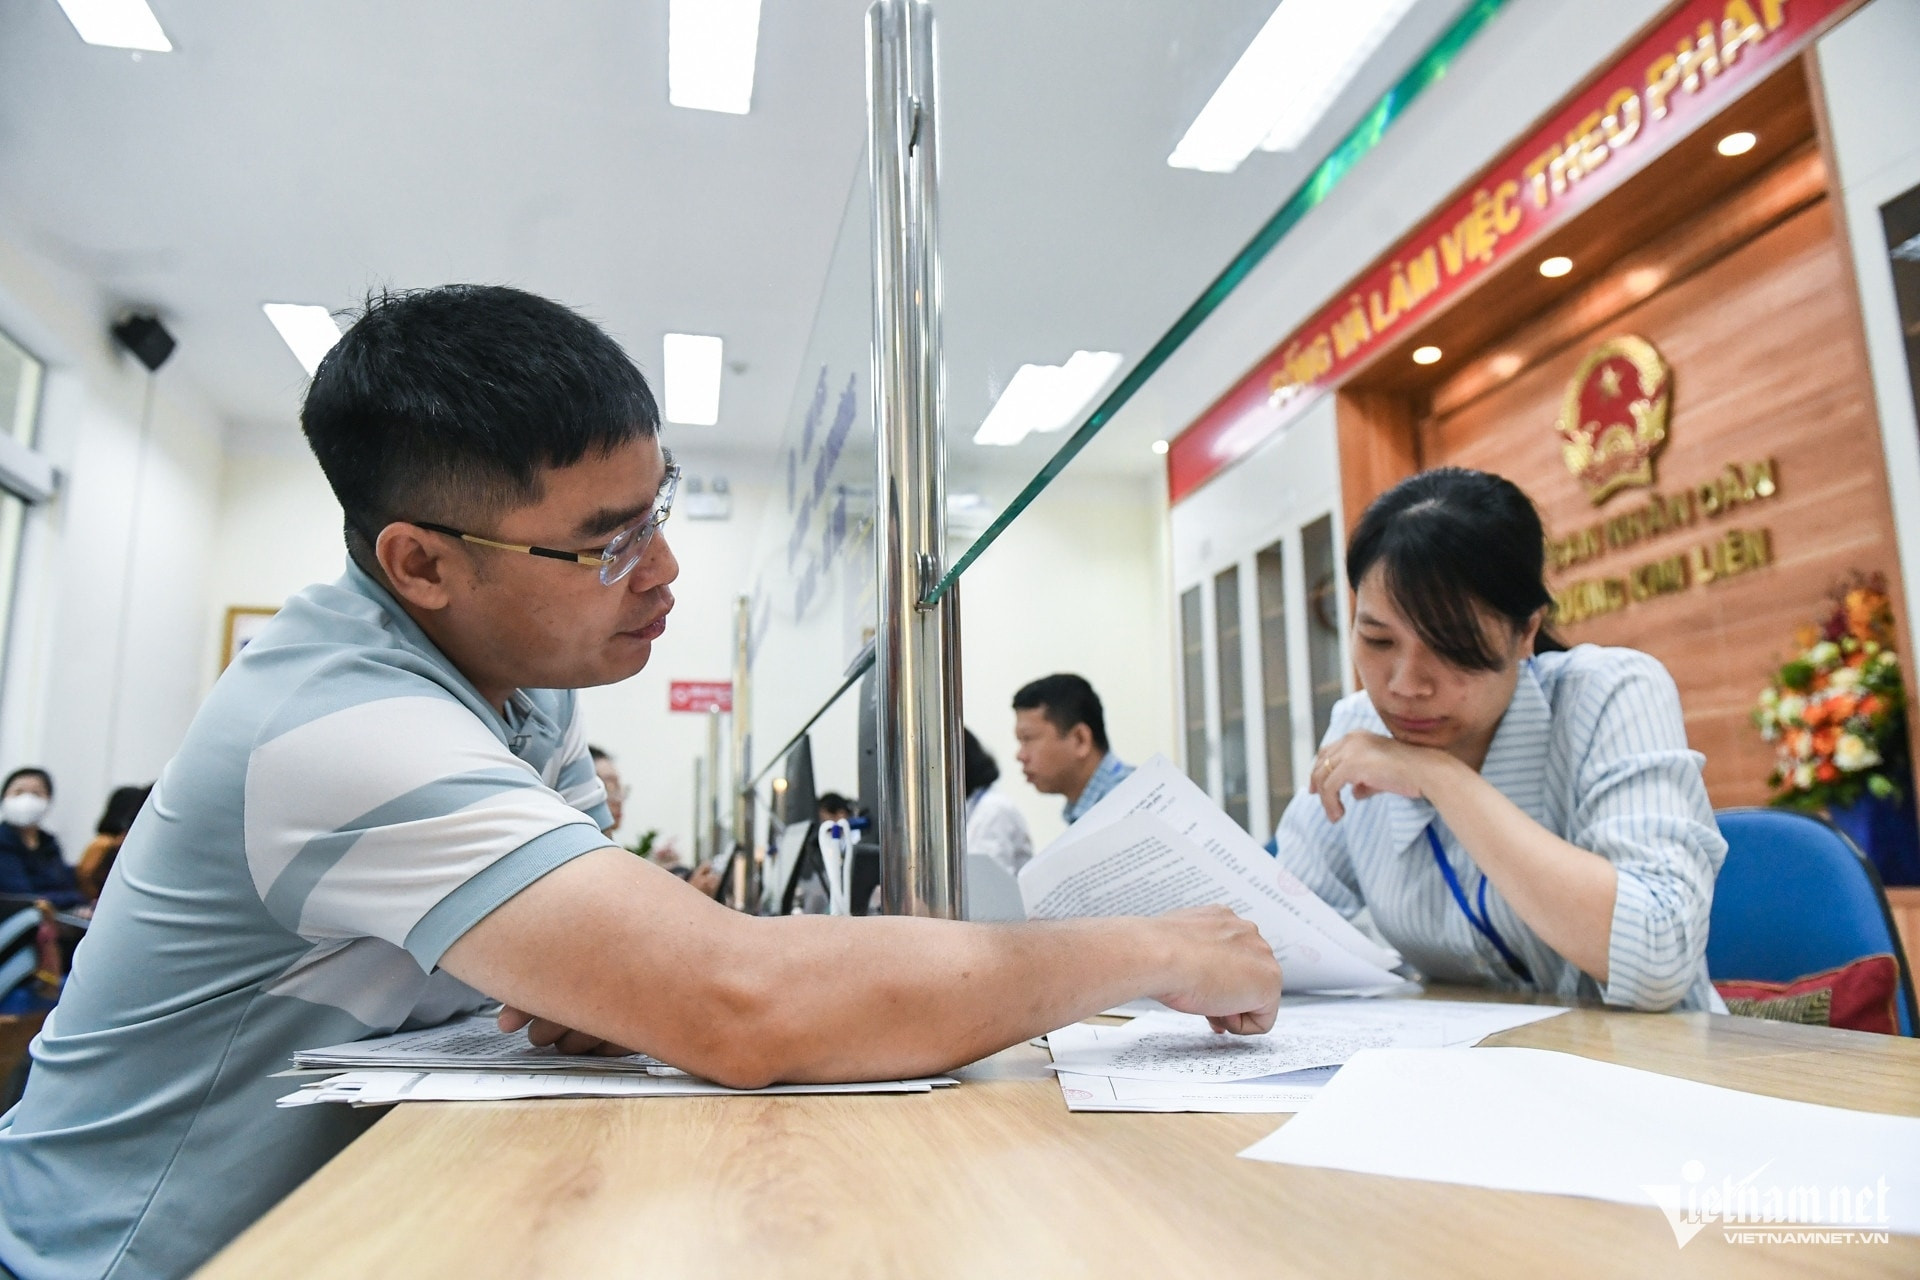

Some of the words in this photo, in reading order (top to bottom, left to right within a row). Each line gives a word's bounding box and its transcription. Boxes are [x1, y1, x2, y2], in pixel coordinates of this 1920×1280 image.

[1369, 246, 1440, 334] LÀM
[1439, 182, 1521, 276] VIỆC
[1524, 87, 1641, 209] THEO
